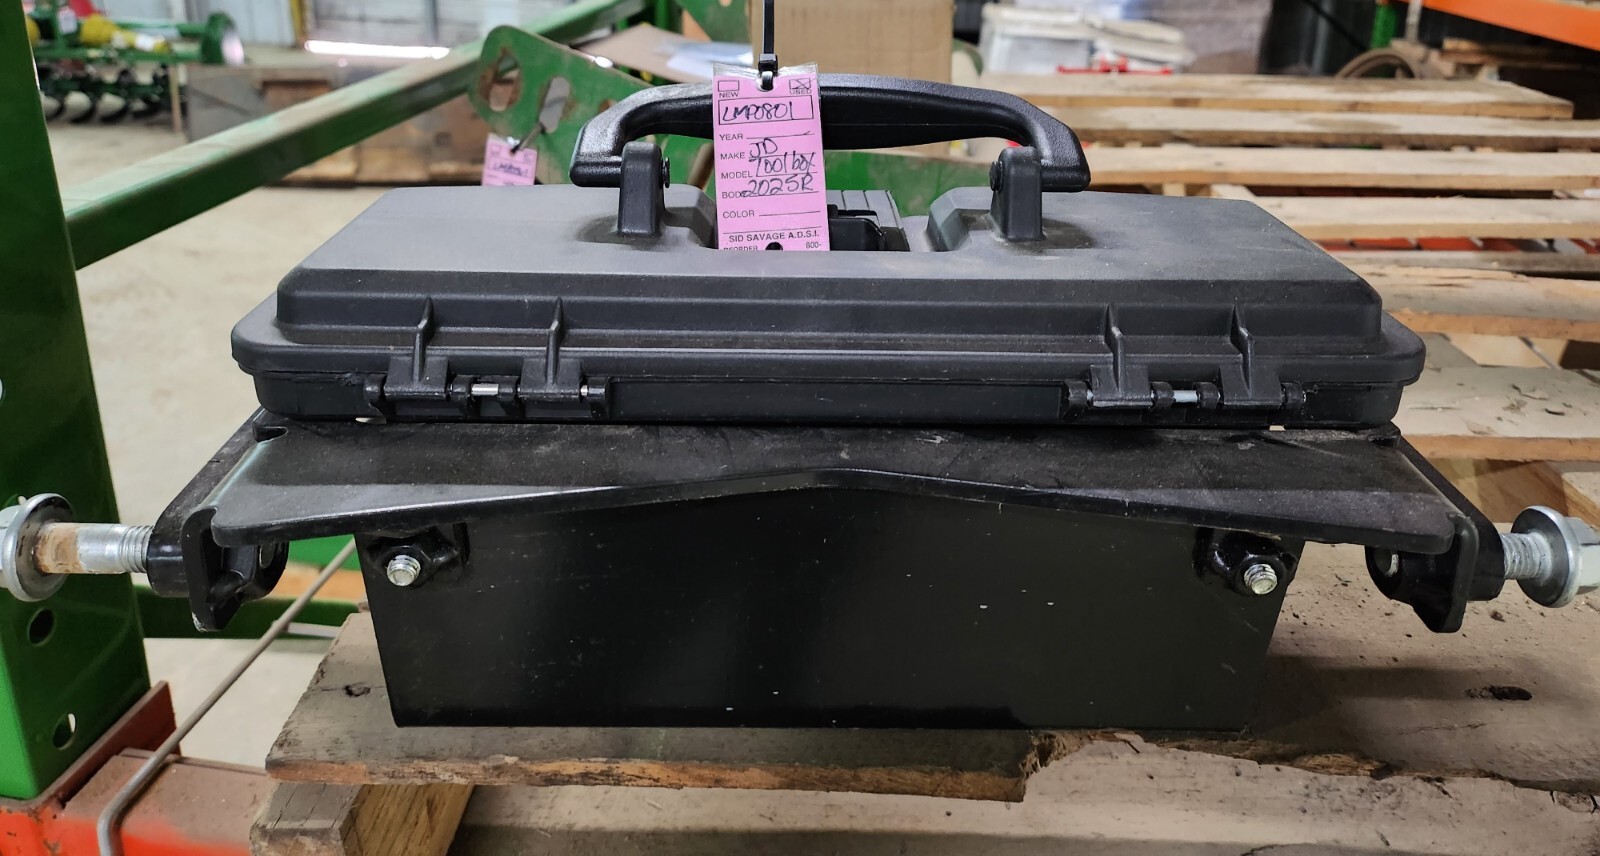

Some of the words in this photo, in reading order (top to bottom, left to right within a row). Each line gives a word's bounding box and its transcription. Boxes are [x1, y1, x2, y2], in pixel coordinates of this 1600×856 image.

[719, 133, 743, 141] YEAR
[749, 137, 778, 160] JD
[720, 152, 745, 160] MAKE
[721, 171, 753, 179] MODEL
[740, 172, 814, 198] 2025R
[722, 210, 755, 219] COLOR
[729, 235, 744, 243] SID
[746, 232, 786, 242] SAVAGE
